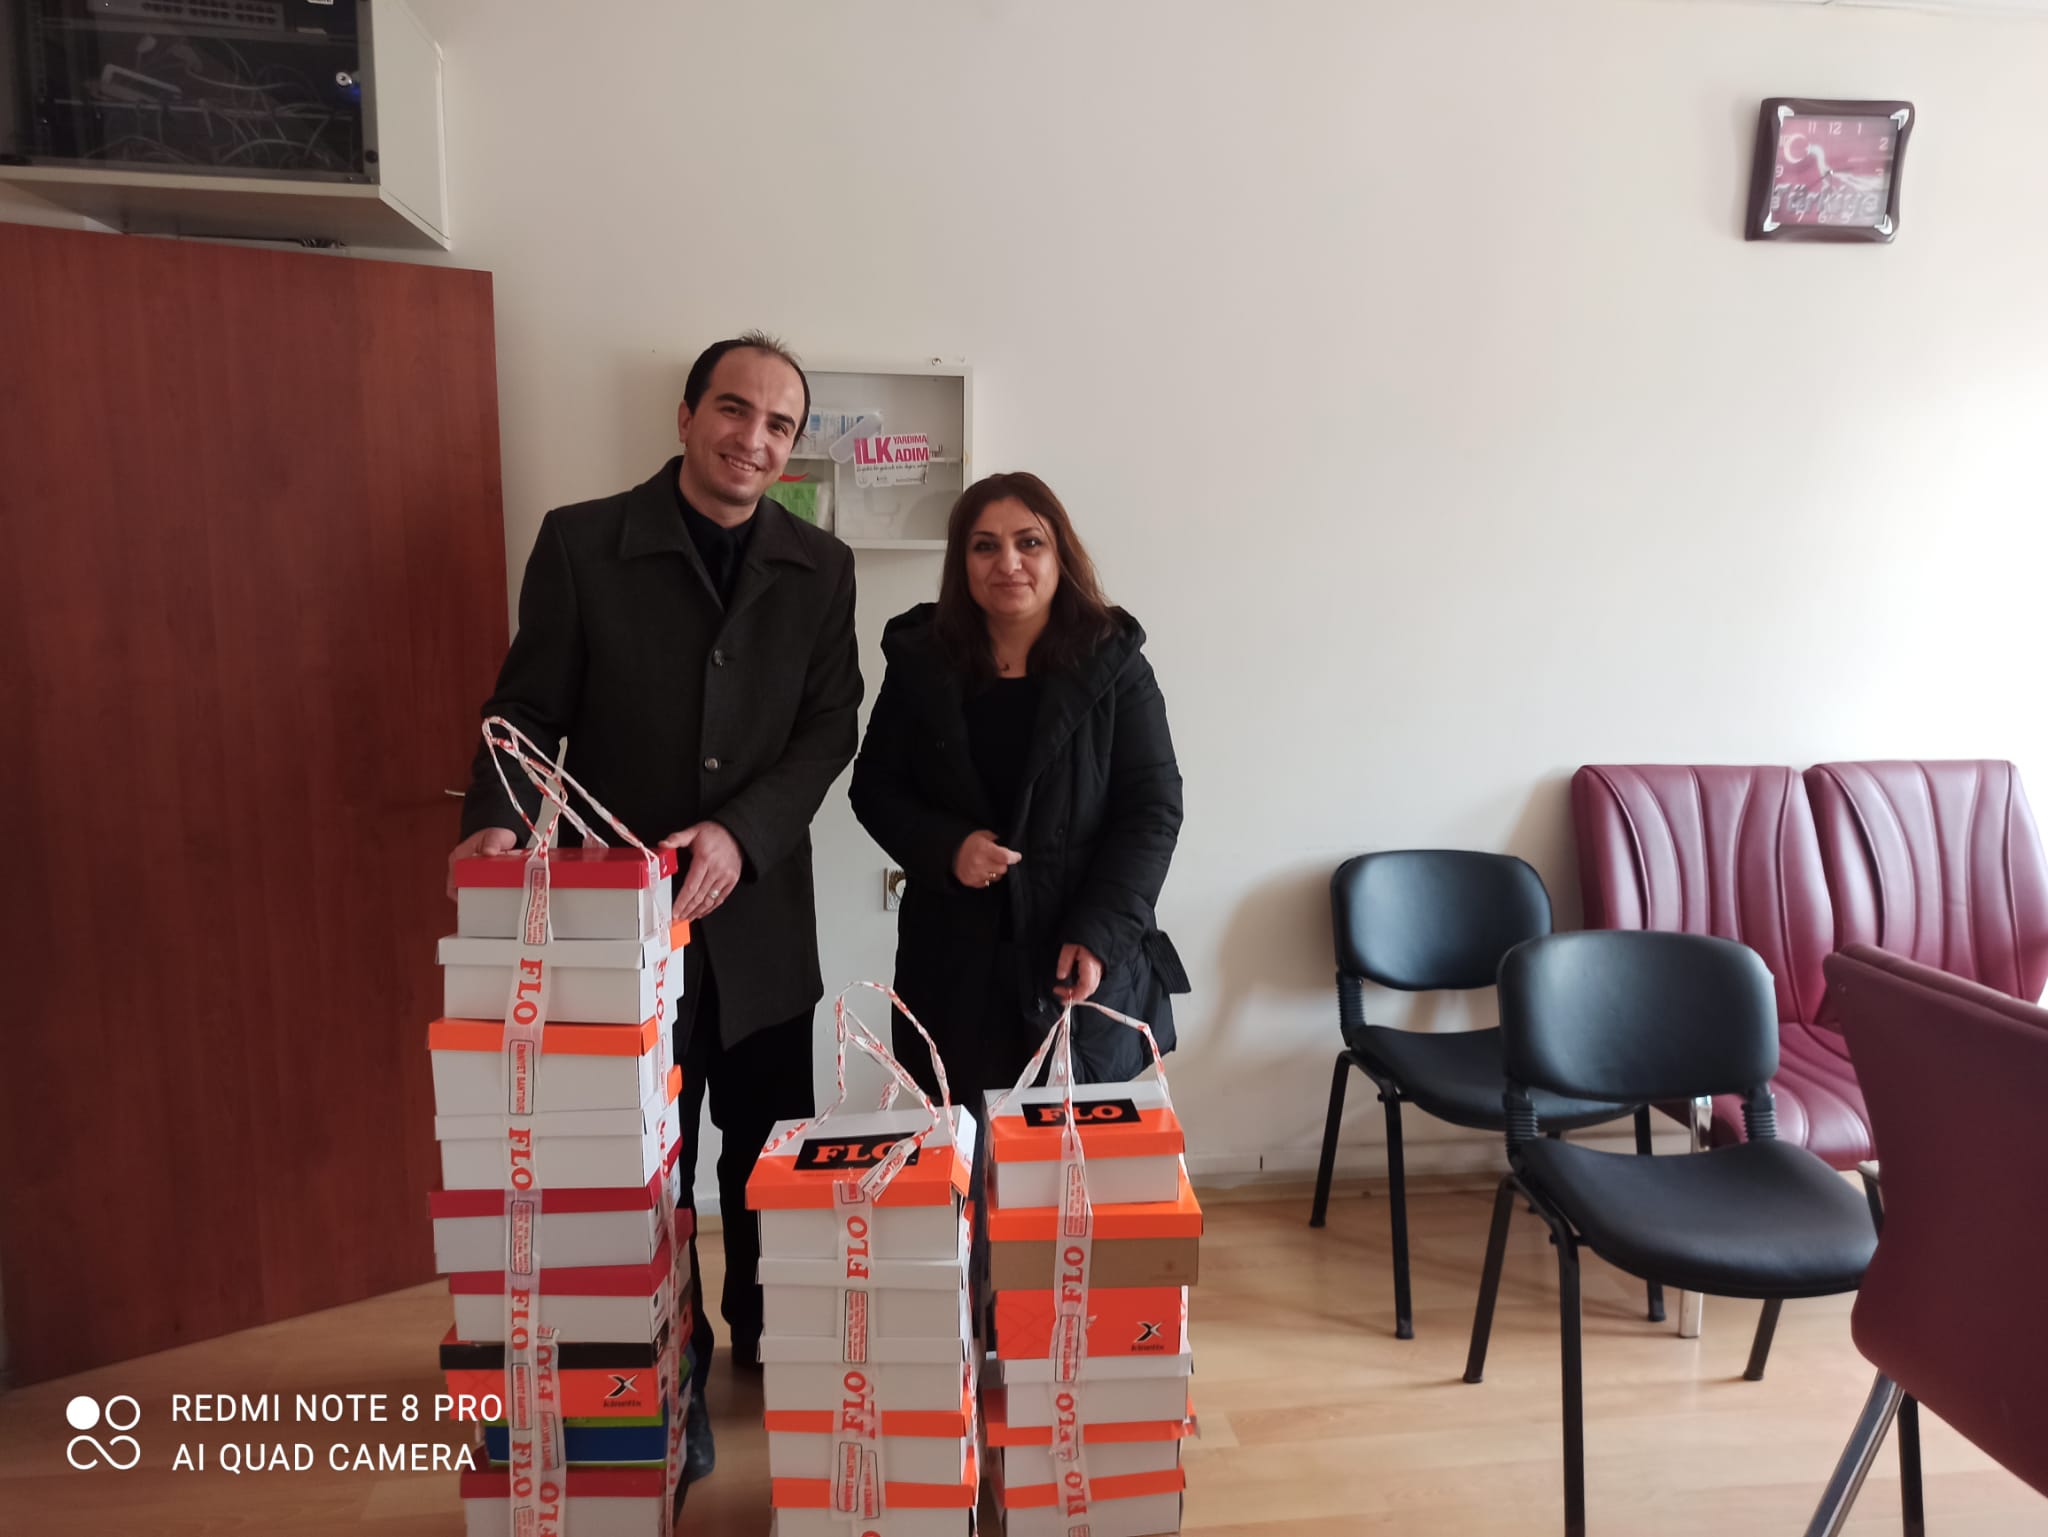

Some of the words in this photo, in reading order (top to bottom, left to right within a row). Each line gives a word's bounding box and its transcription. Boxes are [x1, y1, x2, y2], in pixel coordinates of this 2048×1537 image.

[1829, 121, 1843, 135] 12
[1879, 136, 1889, 150] 2
[513, 957, 543, 1025] FLO
[1038, 1104, 1123, 1123] FLO
[508, 1127, 534, 1191] FLO
[847, 1216, 869, 1279] FLO
[1061, 1246, 1085, 1304] FLO
[510, 1288, 530, 1350] FLO
[842, 1371, 867, 1433] FLO
[512, 1440, 533, 1498] FLO
